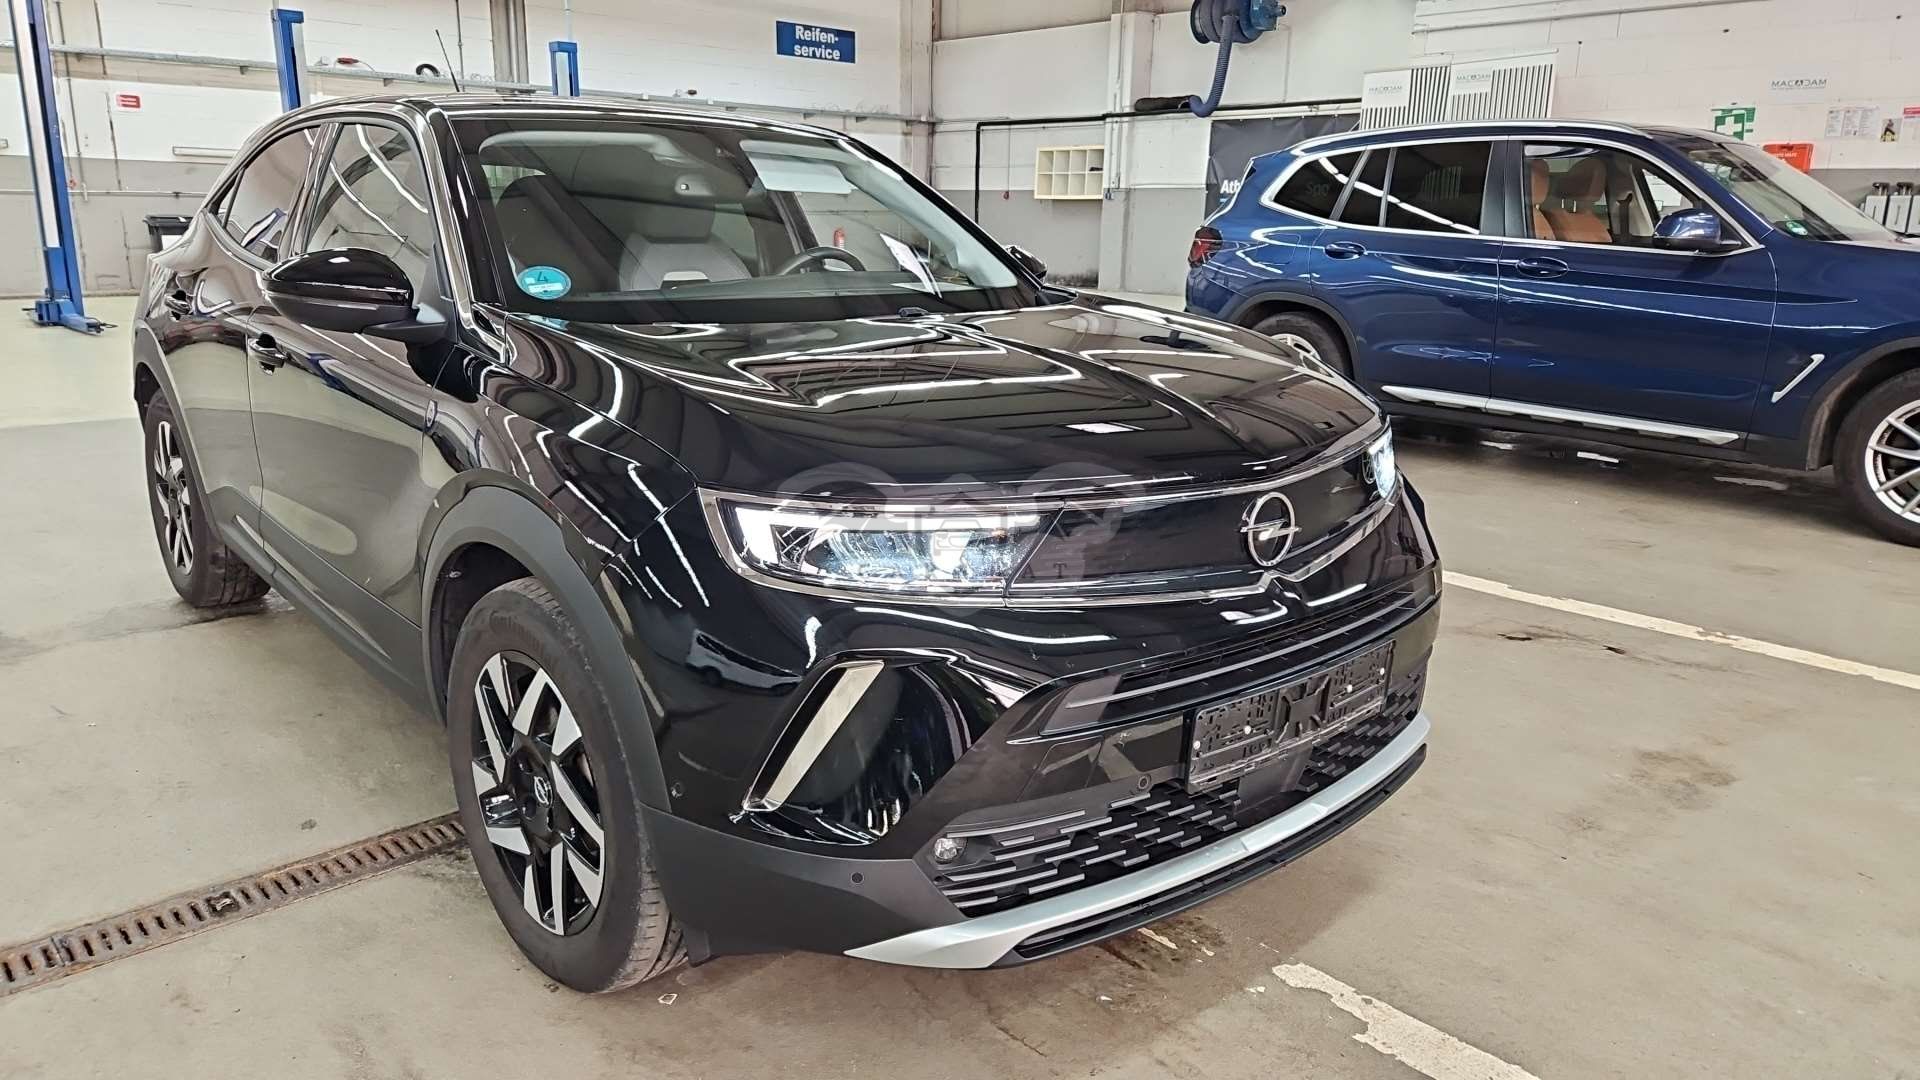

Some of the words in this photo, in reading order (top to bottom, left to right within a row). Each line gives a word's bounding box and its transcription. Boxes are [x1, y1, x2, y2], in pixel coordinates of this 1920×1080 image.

[795, 25, 839, 43] Reifen-
[793, 45, 841, 60] service
[537, 271, 549, 283] 4
